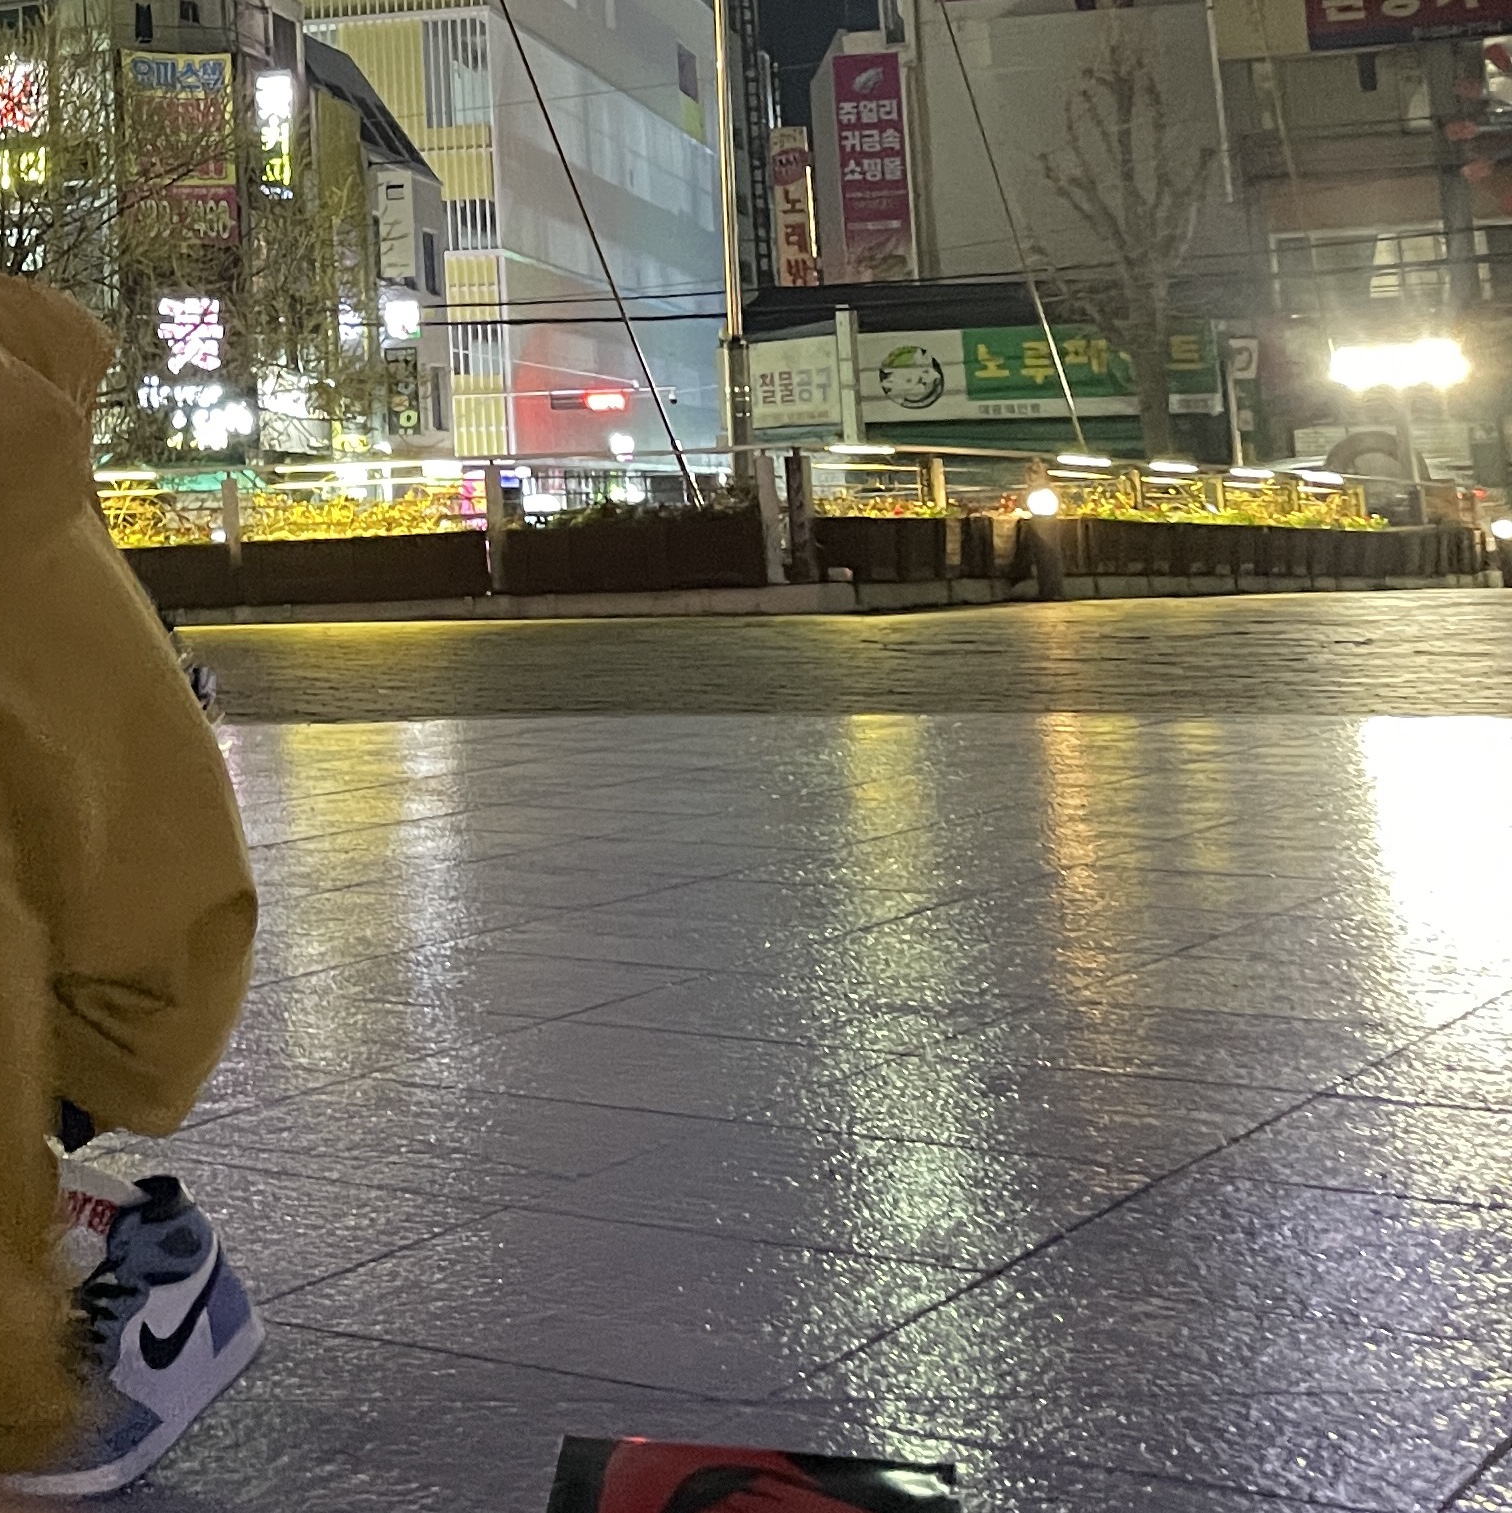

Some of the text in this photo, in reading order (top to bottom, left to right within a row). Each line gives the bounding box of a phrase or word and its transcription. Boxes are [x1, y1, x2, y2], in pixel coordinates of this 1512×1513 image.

[839, 99, 898, 125] 쥬얼리
[841, 128, 901, 153] 귀금속
[843, 156, 904, 181] 쇼핑몰
[779, 187, 814, 286] 노래방
[974, 334, 1206, 385] 노루페트
